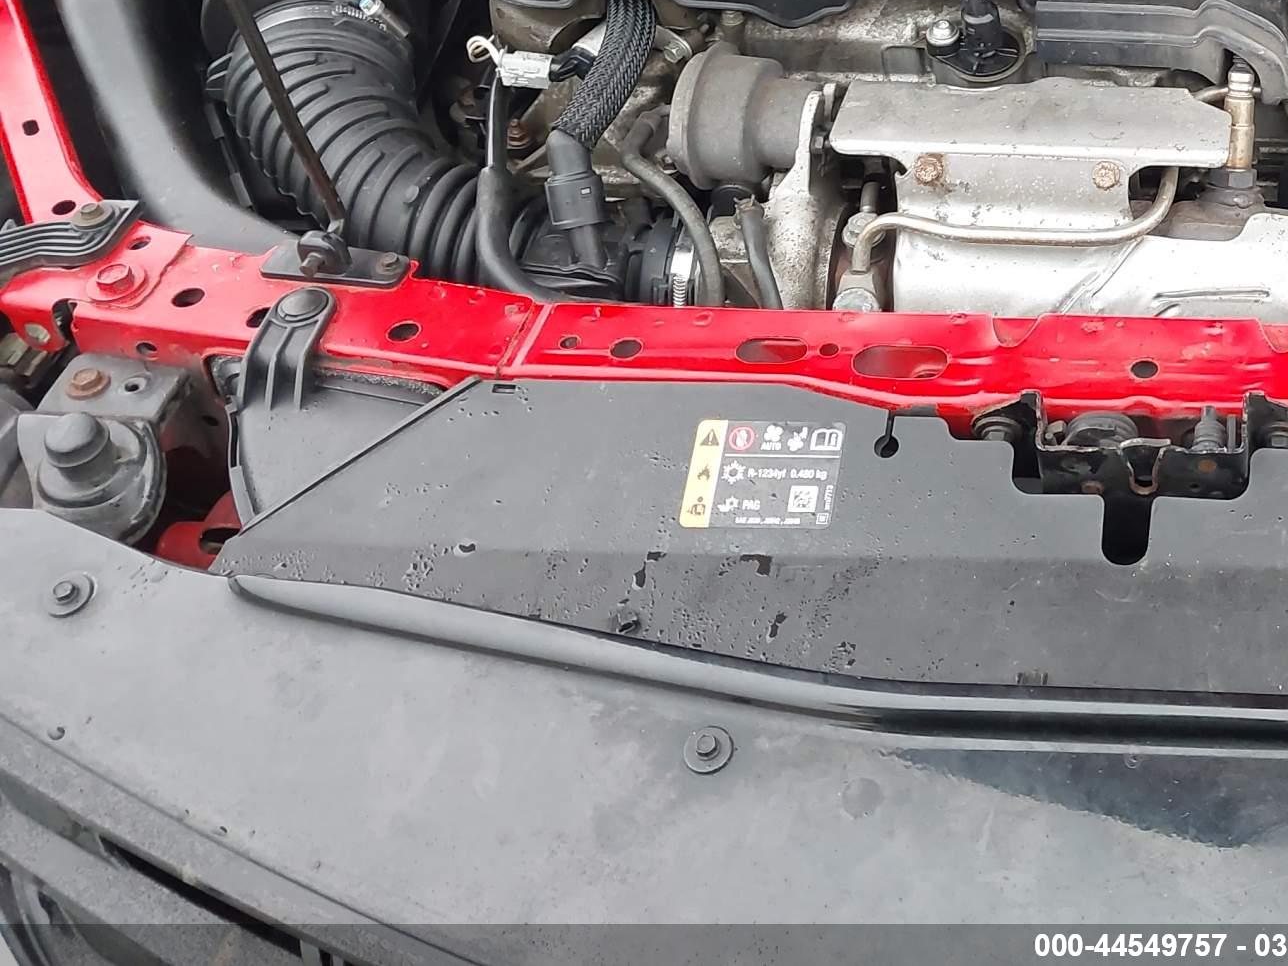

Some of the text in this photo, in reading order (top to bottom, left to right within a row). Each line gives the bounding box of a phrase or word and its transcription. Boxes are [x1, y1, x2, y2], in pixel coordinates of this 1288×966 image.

[760, 441, 782, 451] AUTO
[815, 469, 828, 481] kg
[741, 499, 761, 511] PAG
